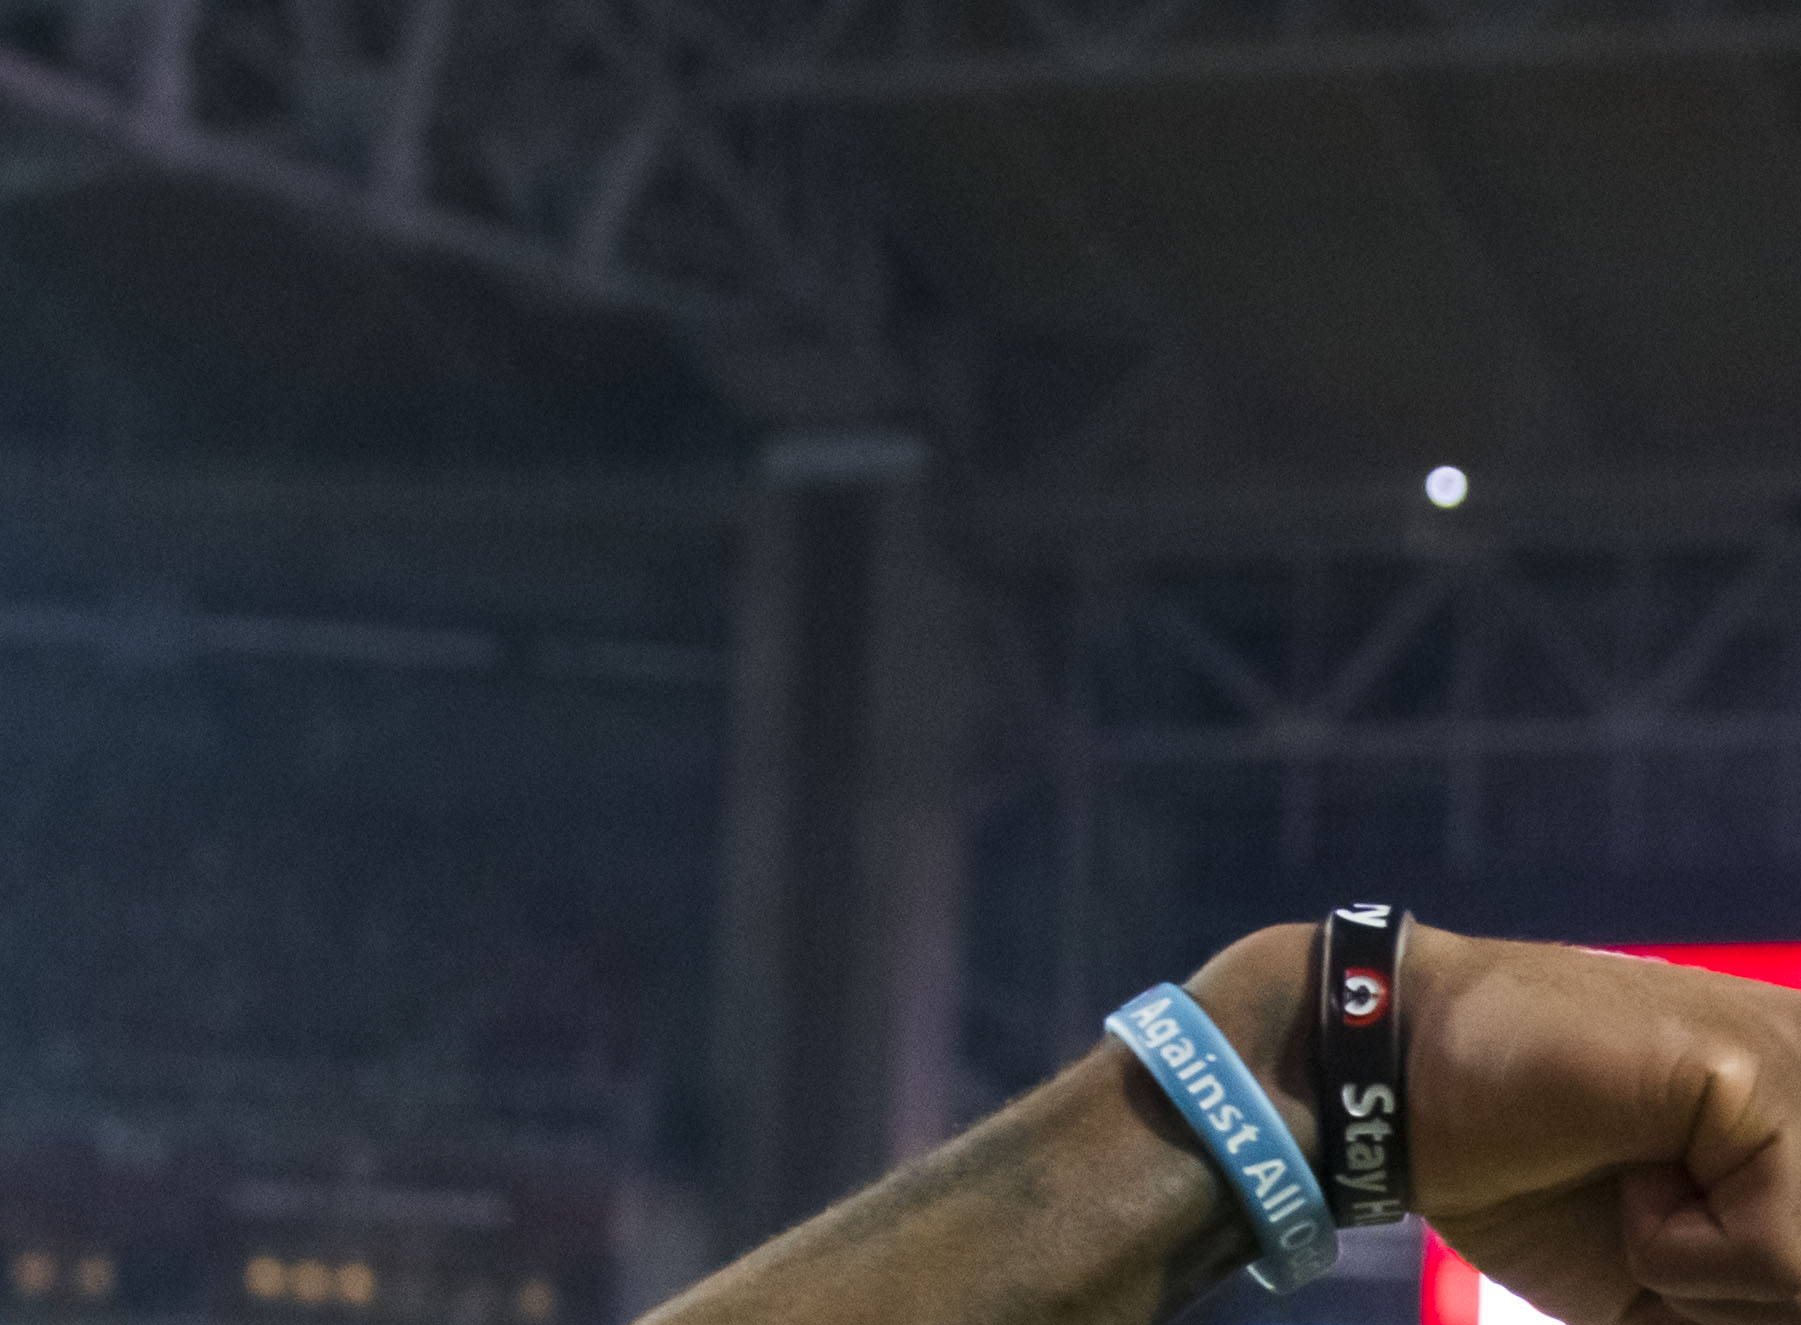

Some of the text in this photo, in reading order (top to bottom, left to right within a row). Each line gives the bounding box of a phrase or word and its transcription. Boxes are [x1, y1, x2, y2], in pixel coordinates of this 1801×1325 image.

[1129, 997, 1259, 1155] Against
[1242, 1158, 1305, 1224] All
[1334, 1082, 1395, 1193] Stay
